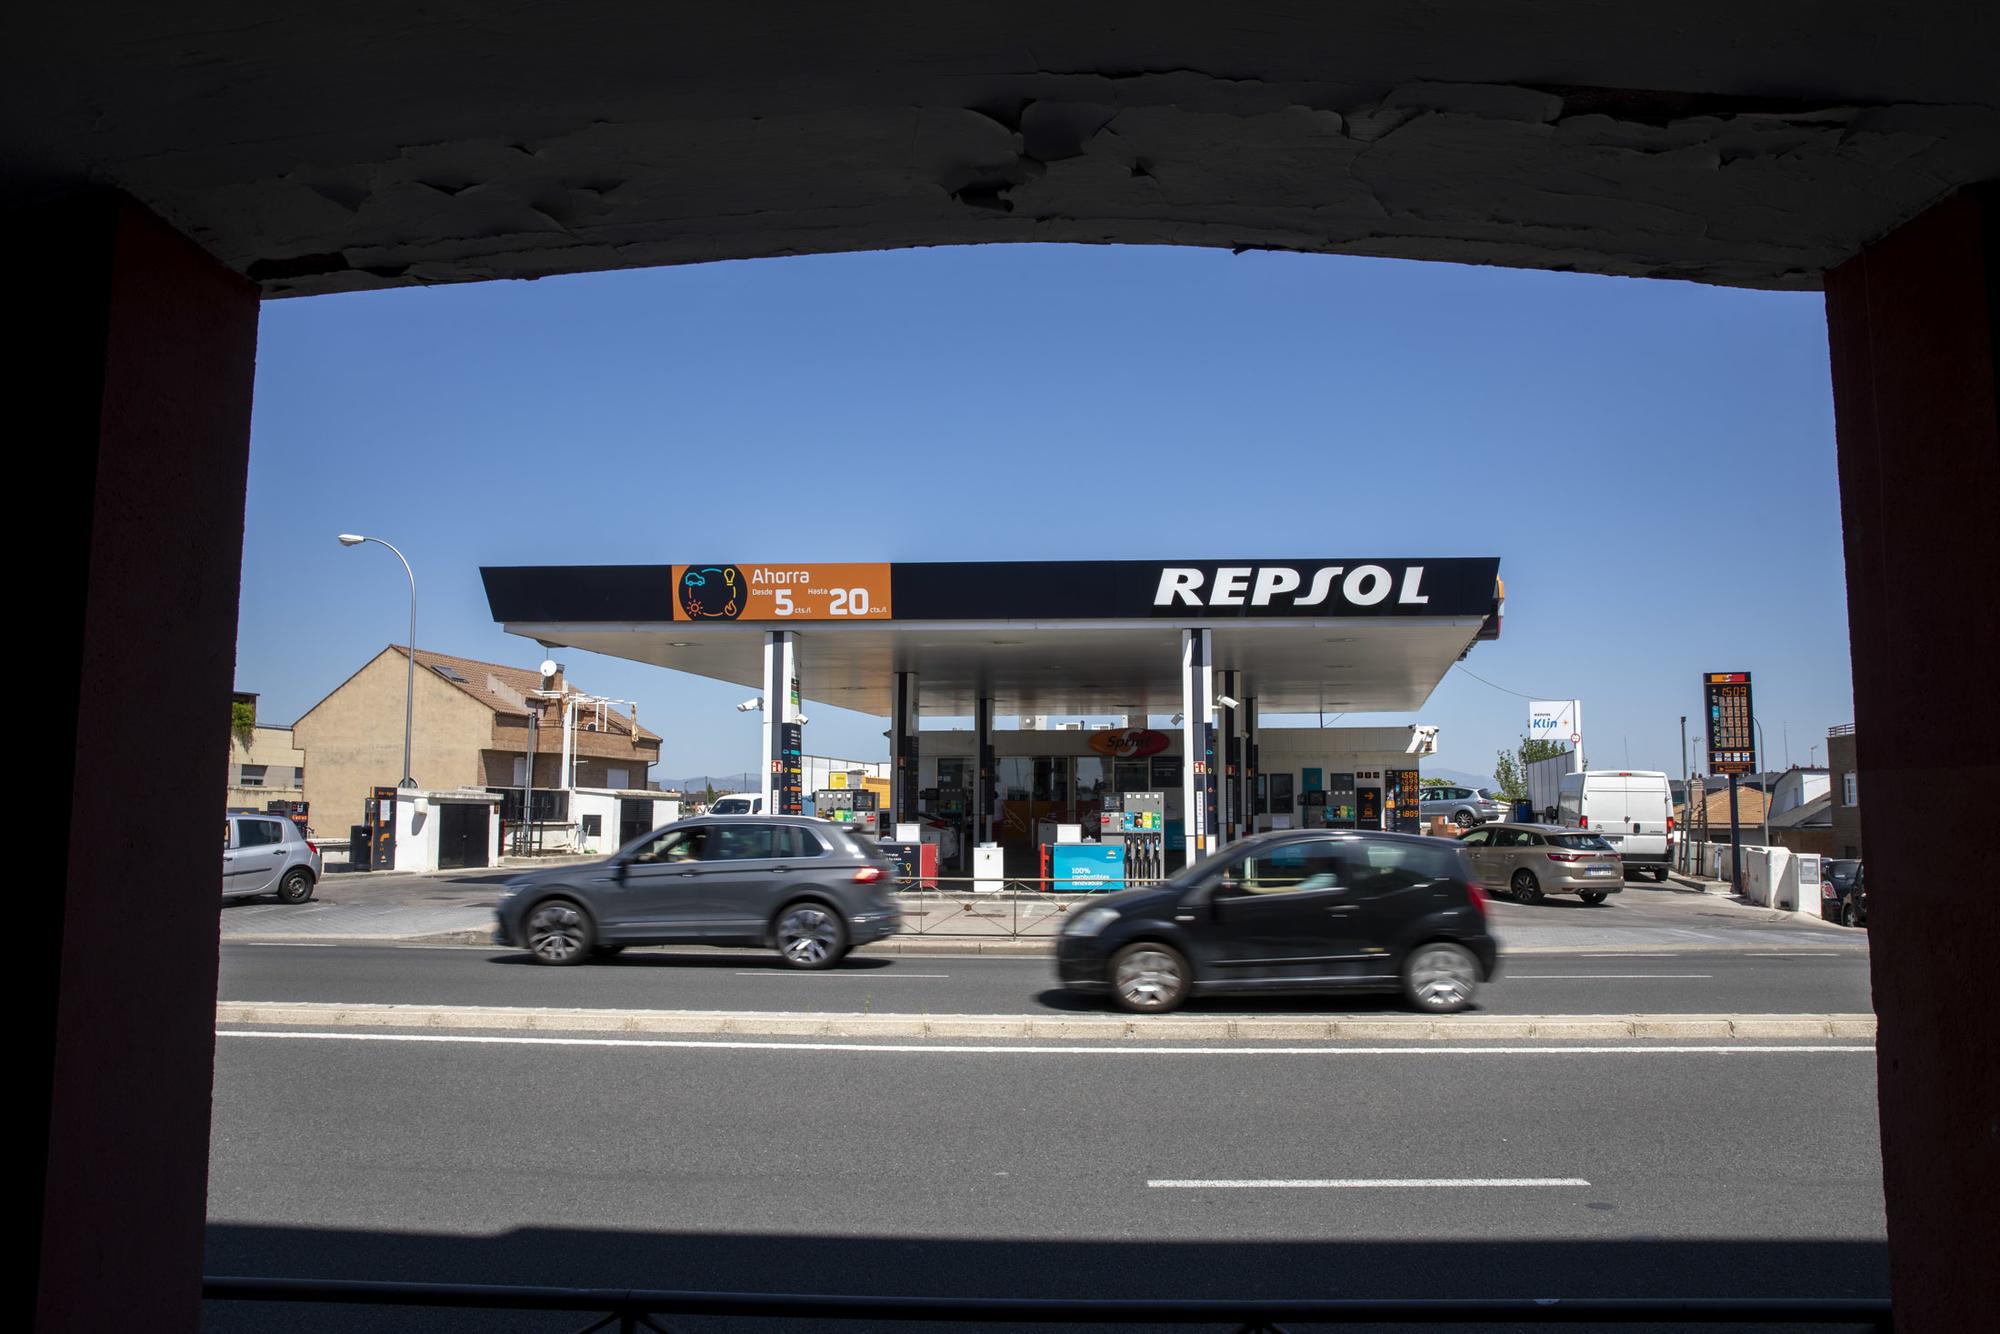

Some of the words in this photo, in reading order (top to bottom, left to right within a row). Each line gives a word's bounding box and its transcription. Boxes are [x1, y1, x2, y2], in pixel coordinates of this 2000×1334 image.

[752, 568, 810, 584] Ahorra
[1153, 564, 1429, 606] REPSOL
[752, 588, 773, 596] Desde
[774, 588, 794, 615] 5
[829, 588, 869, 615] 20
[1533, 718, 1558, 728] Klin
